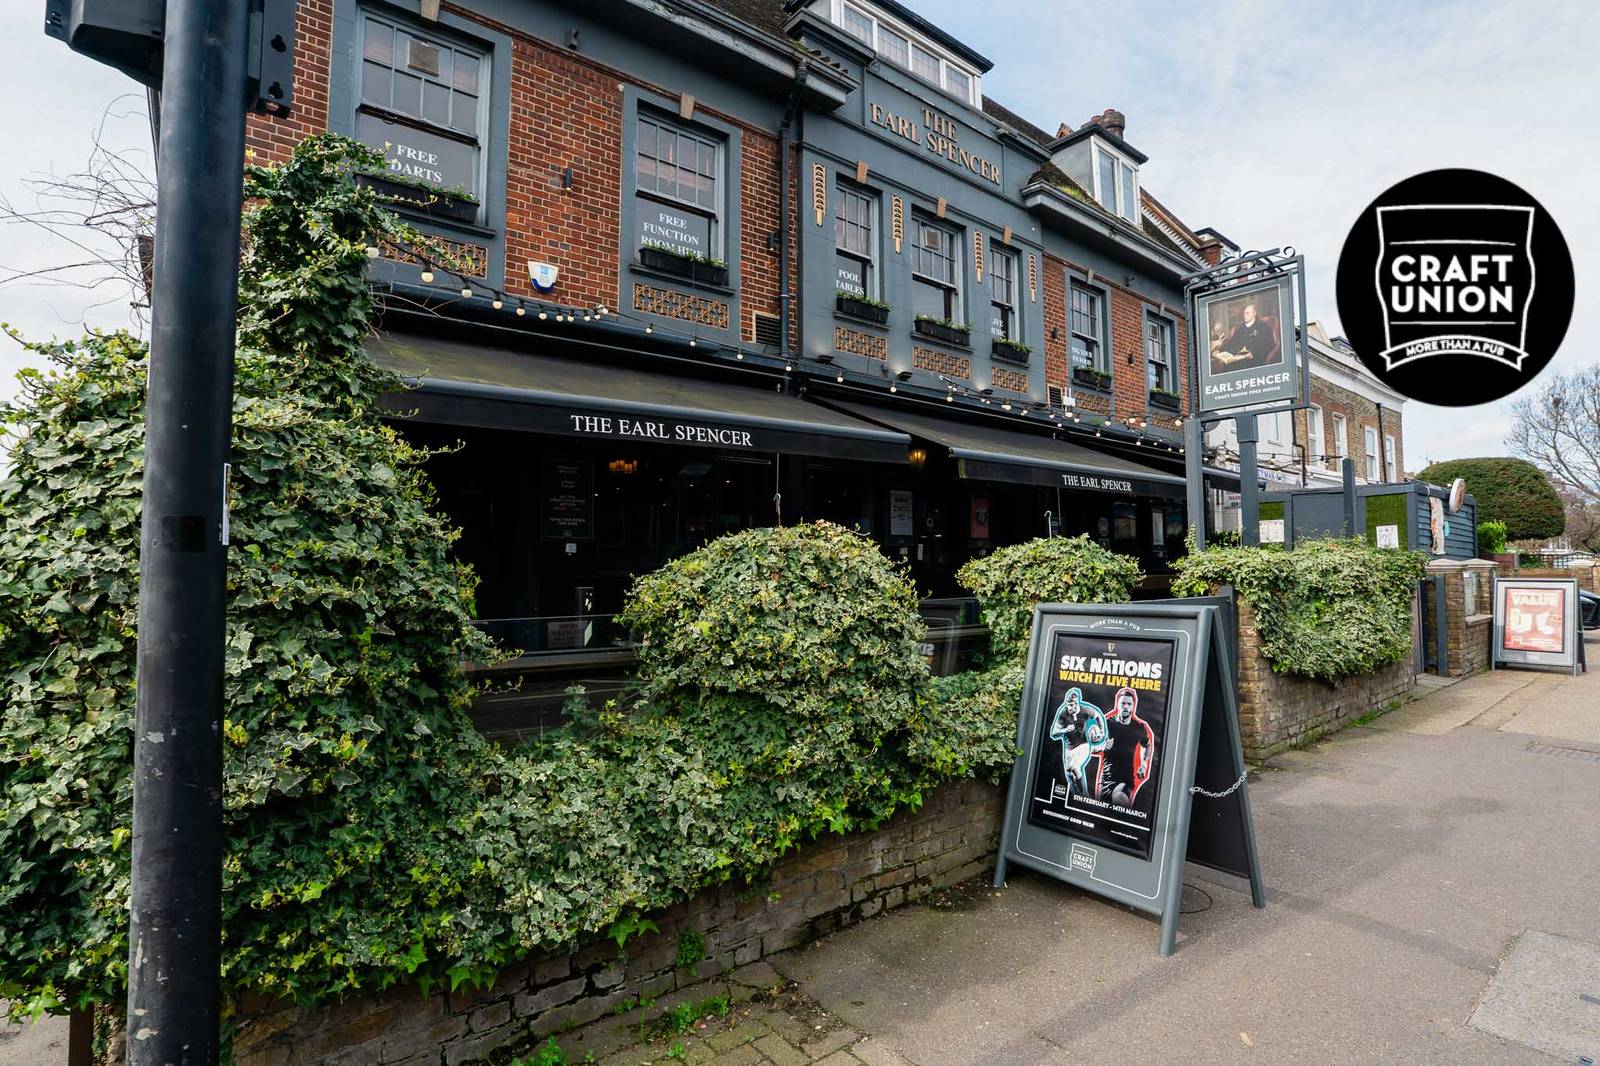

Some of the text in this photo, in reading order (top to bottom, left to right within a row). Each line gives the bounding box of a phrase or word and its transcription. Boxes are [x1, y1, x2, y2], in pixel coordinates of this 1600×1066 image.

[921, 107, 957, 142] THE
[870, 103, 1000, 185] EARL SPENCER
[396, 144, 438, 166] FREE
[390, 159, 442, 183] DARTS
[658, 212, 688, 230] FREE
[643, 222, 700, 246] FUNCTION
[838, 268, 861, 283] POOL
[835, 279, 865, 295] TABLES
[1205, 372, 1290, 395] EARL SPENCER
[1214, 393, 1231, 401] CRAFT
[571, 414, 752, 447] THE EARL SPENCER
[1062, 474, 1132, 492] THE EARL SPENCER
[1090, 620, 1106, 629] MORE
[1129, 622, 1141, 631] PUB
[1060, 655, 1162, 679] SIX NATIONS
[1059, 670, 1161, 691] WATCH IT LIVE HERE
[1073, 794, 1083, 802] 5TH
[1083, 796, 1109, 809] FEBRUARY
[1112, 804, 1125, 813] 14TH
[1125, 808, 1147, 819] MARCH
[1072, 858, 1092, 870] UNION
[1073, 853, 1093, 864] CRAFT
